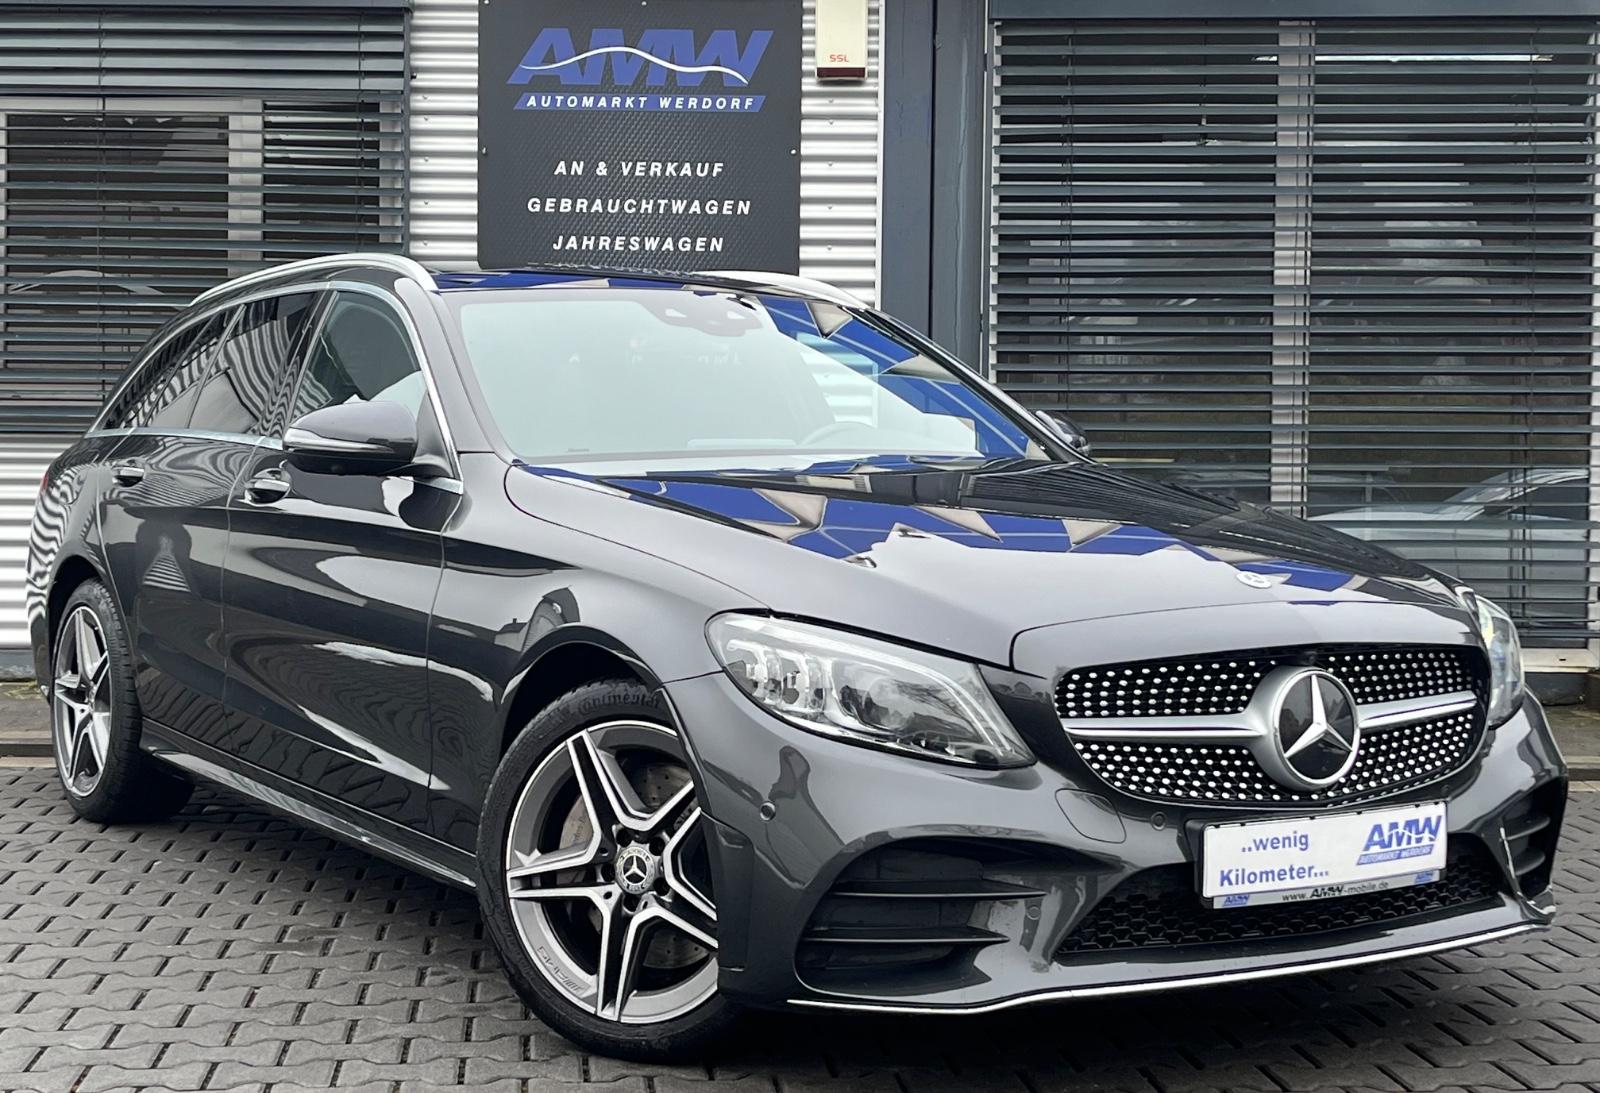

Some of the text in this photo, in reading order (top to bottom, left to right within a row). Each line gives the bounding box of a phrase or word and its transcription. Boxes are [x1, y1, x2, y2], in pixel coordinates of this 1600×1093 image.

[506, 28, 774, 87] AMW
[829, 54, 849, 63] SSL
[526, 95, 755, 110] AUTOMARKT WERDORF
[554, 160, 725, 177] AN & VERKAUF
[527, 198, 752, 216] GEBRAUCHTWAGEN
[552, 236, 725, 253] JAHRESWAGEN
[1363, 815, 1443, 851] AMW
